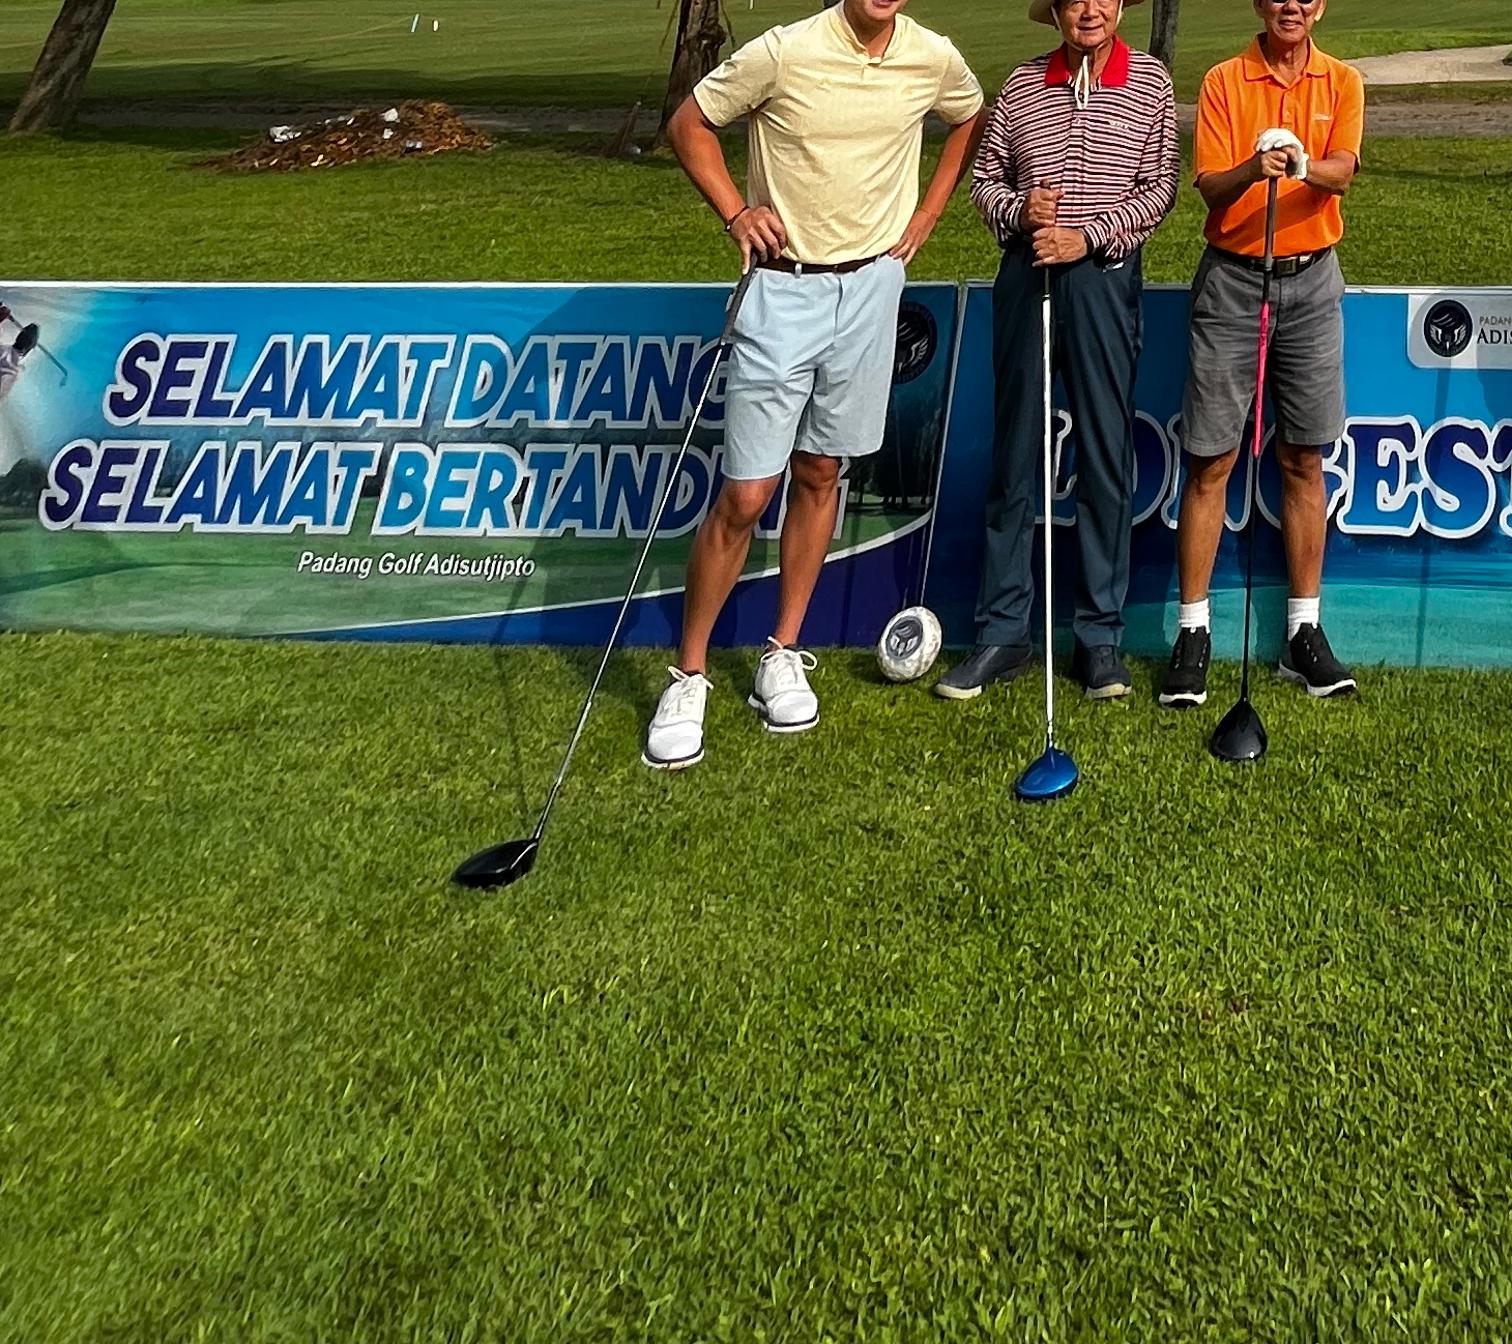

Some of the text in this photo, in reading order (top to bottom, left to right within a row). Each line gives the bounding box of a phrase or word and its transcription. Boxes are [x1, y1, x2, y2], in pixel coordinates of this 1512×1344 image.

[103, 333, 457, 427] SELAMAT
[38, 438, 850, 540] SELAMAT BERTAND
[297, 551, 536, 581] Padang Golf Adisutjipto
